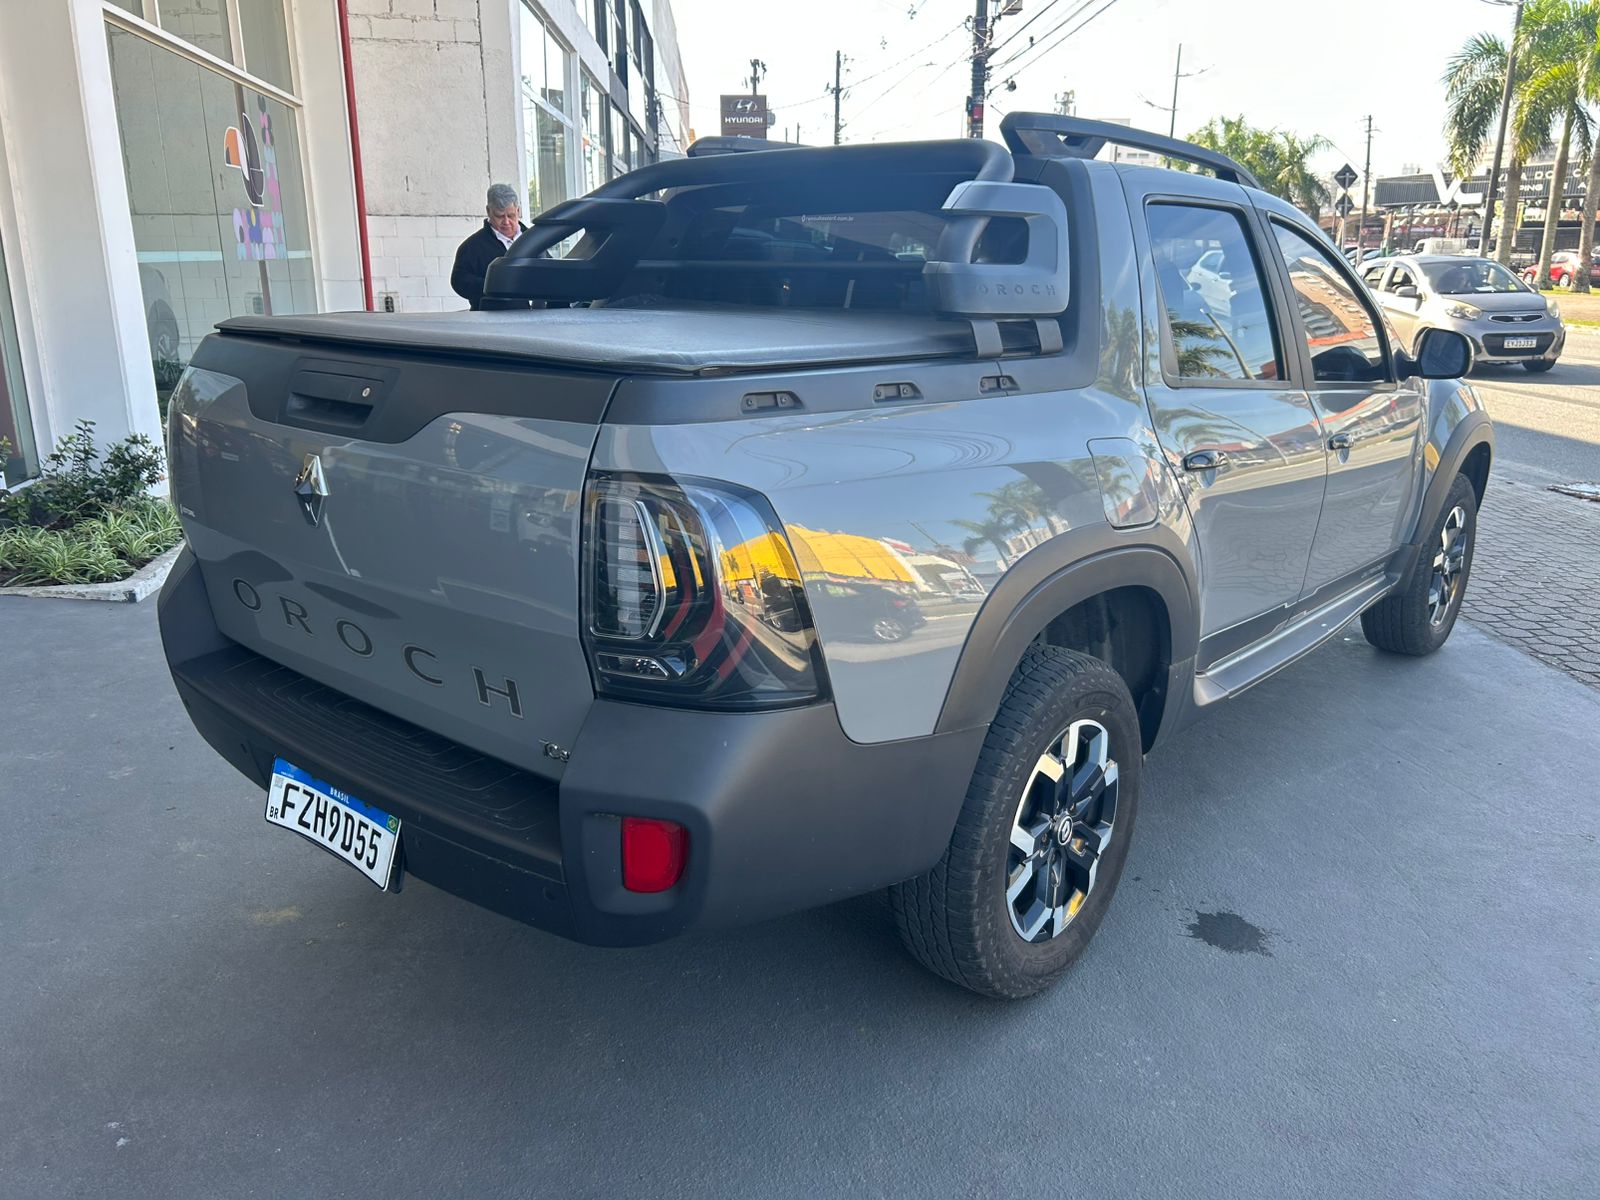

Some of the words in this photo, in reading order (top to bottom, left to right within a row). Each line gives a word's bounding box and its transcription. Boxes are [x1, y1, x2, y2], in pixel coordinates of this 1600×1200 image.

[725, 116, 763, 124] HYUNDAI
[977, 283, 1056, 296] OROCH
[232, 577, 523, 719] OROCH
[330, 787, 349, 804] BRASIL
[269, 806, 279, 820] BR
[280, 782, 382, 870] FZH9D55
